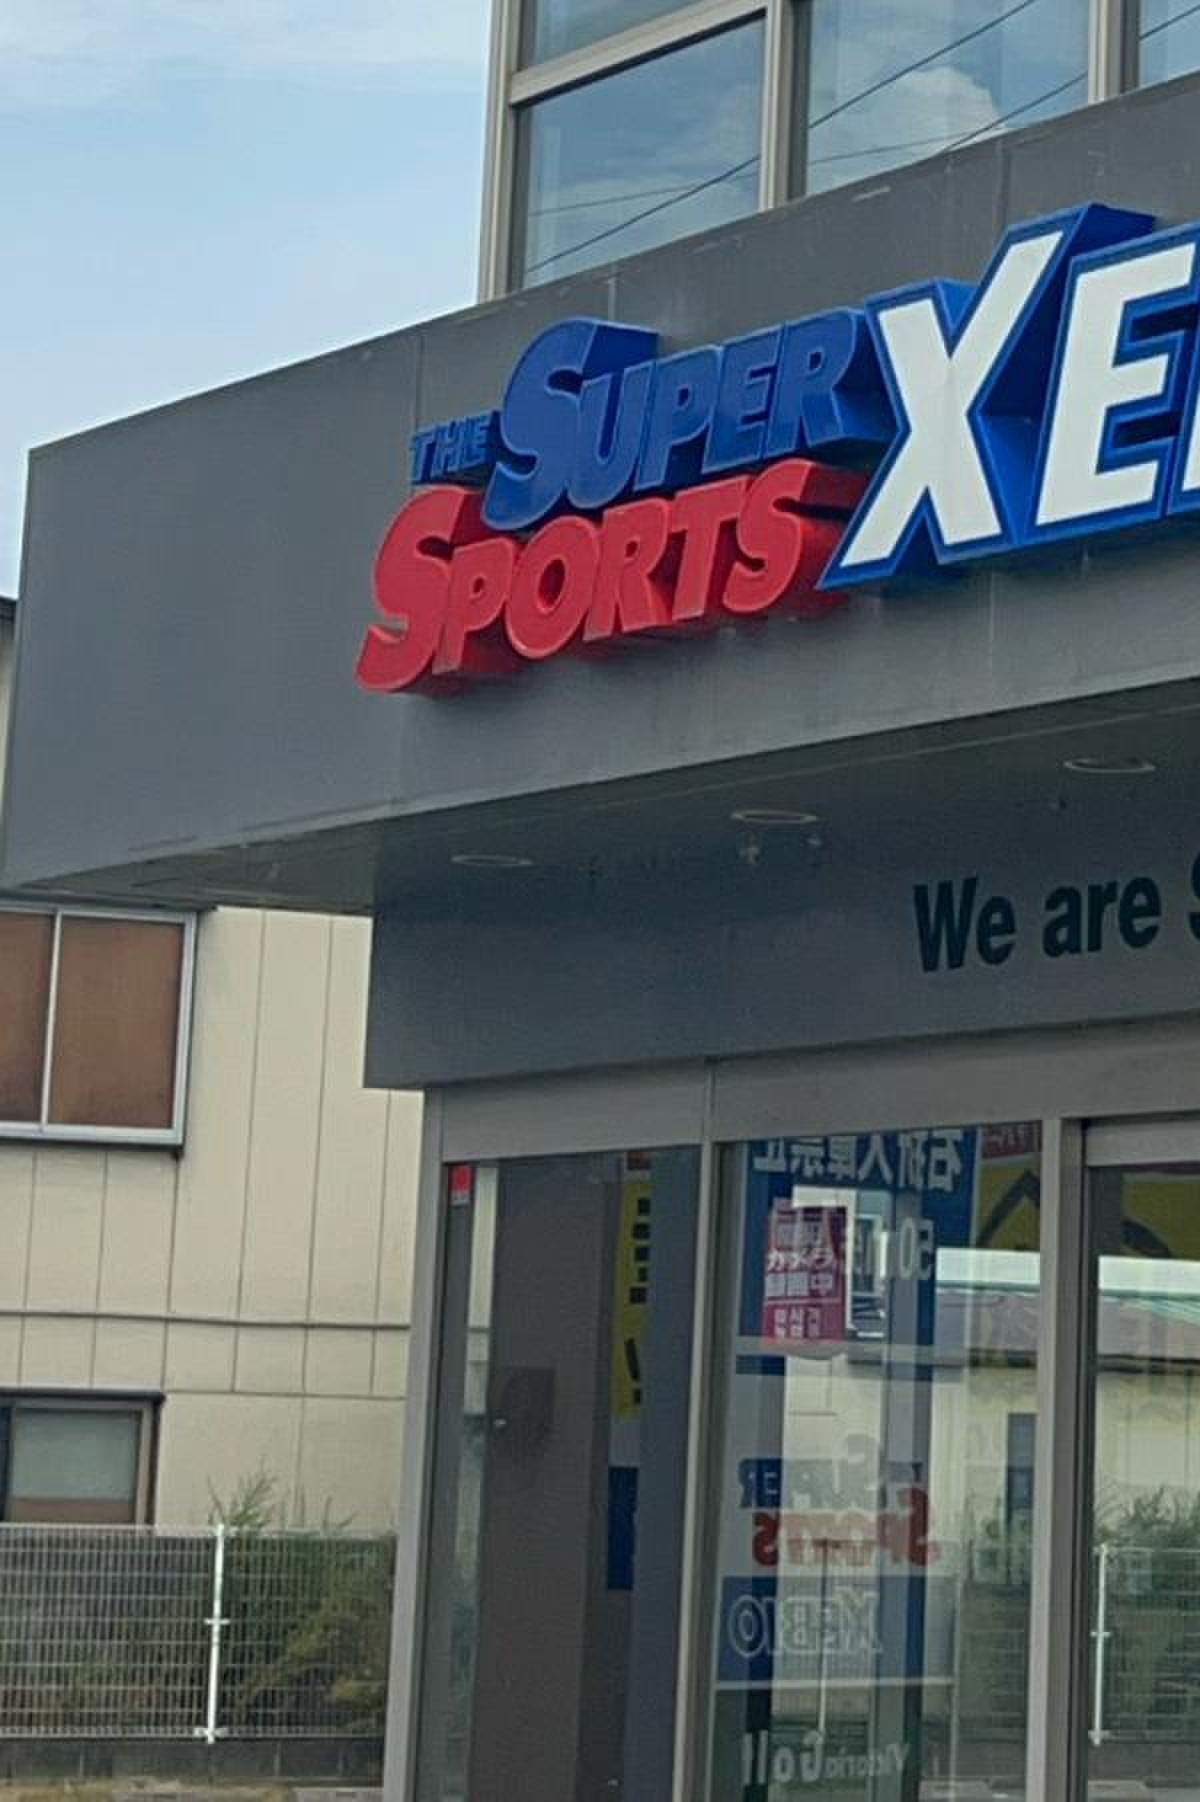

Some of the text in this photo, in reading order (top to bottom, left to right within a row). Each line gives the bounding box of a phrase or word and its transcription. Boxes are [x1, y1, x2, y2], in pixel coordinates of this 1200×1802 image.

[411, 316, 868, 530] THE SUPER
[353, 457, 820, 692] SPORTS
[913, 877, 1017, 973] We
[1042, 876, 1162, 958] are
